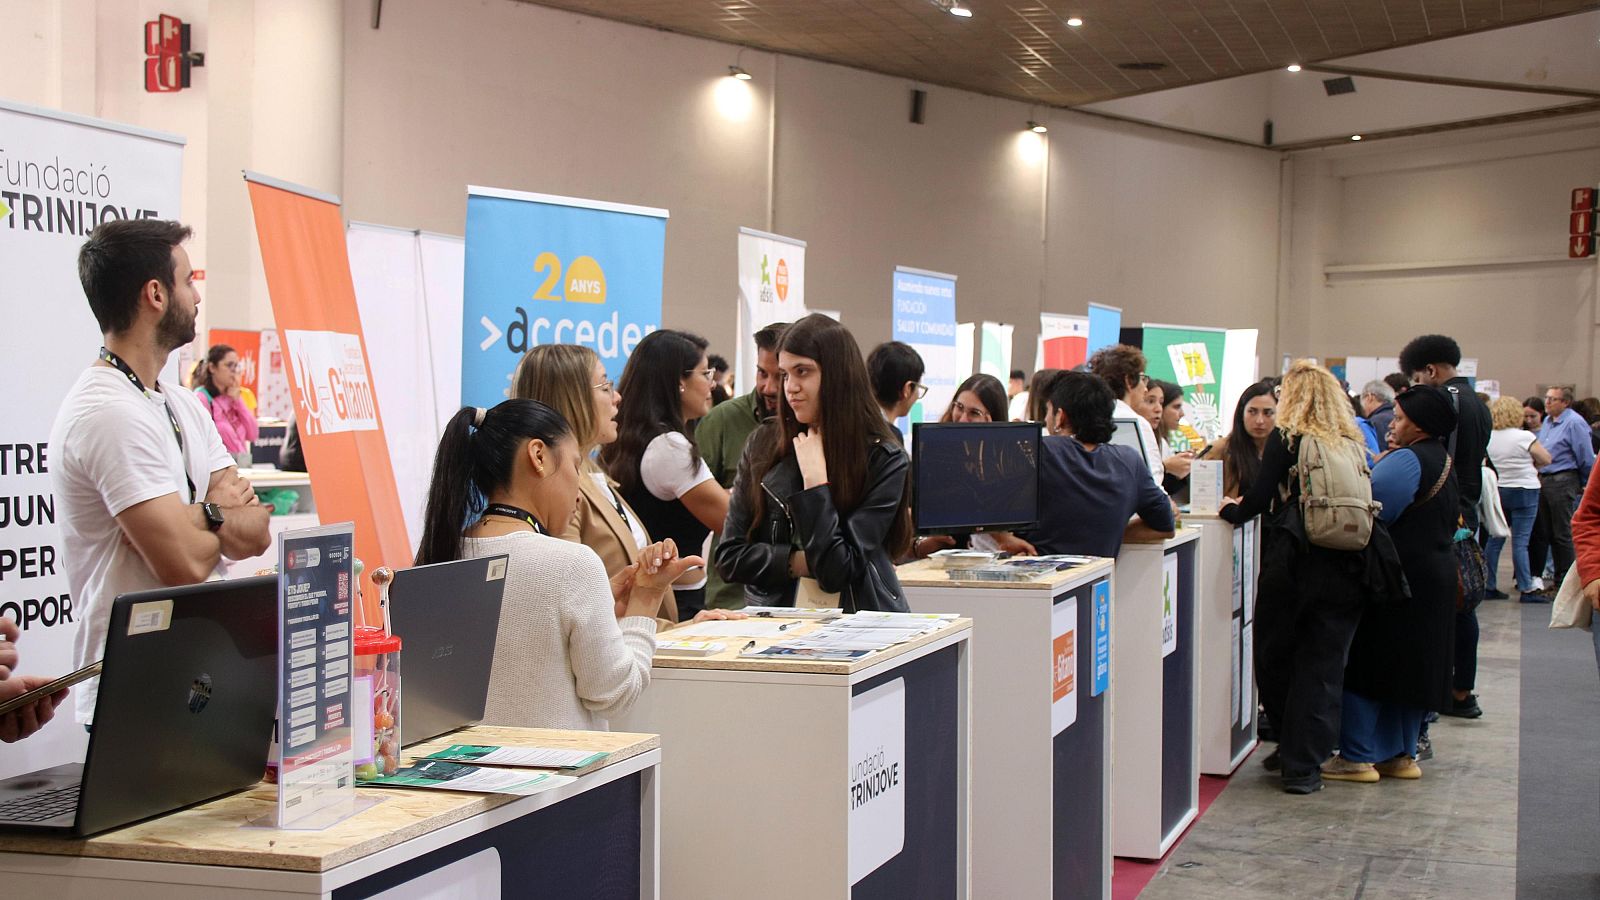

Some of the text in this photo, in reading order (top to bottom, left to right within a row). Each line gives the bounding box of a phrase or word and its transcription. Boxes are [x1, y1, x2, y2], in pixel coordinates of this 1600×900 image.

[2, 190, 159, 237] TRINIJ
[570, 278, 601, 295] ANYS
[0, 442, 49, 475] TRE
[0, 494, 55, 528] JUN
[0, 545, 56, 580] PER
[850, 761, 898, 812] TRINIJOVE
